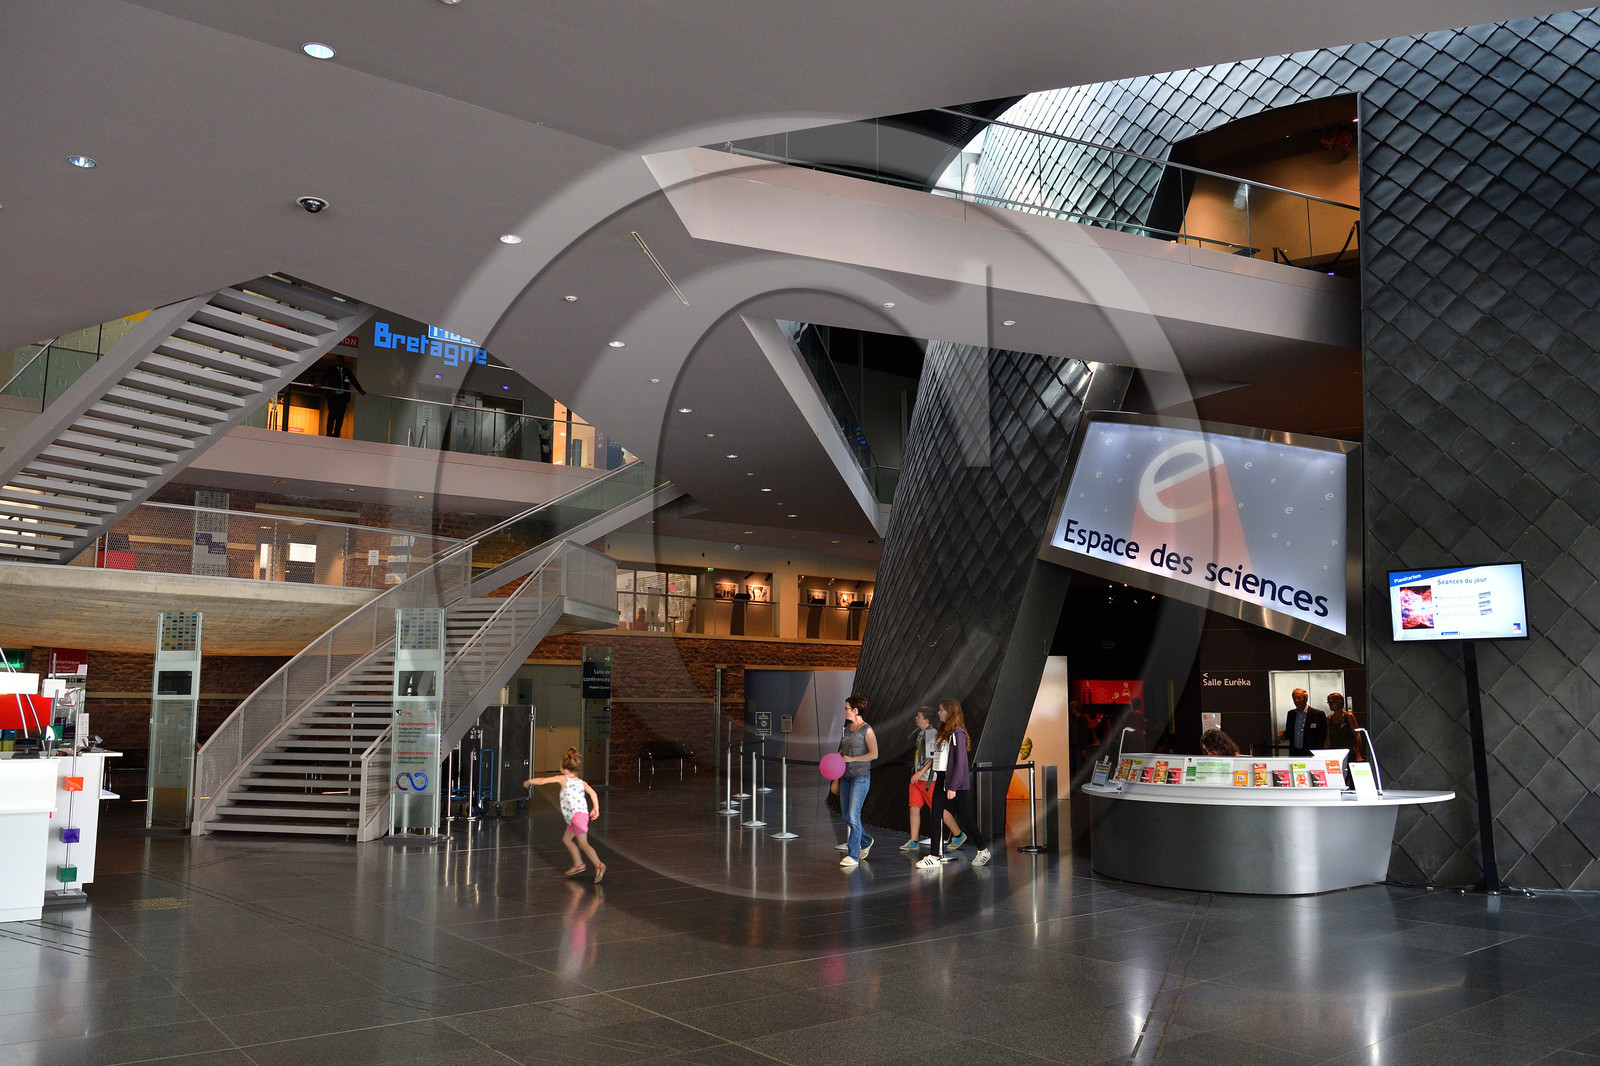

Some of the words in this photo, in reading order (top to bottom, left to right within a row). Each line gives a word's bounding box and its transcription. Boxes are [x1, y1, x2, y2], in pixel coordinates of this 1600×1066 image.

[374, 322, 487, 367] Bretagne
[1064, 519, 1140, 559] Espace
[1150, 544, 1193, 575] des
[1204, 562, 1329, 617] sciences
[1394, 574, 1421, 584] Planétarium
[1224, 678, 1251, 686] Eurêka
